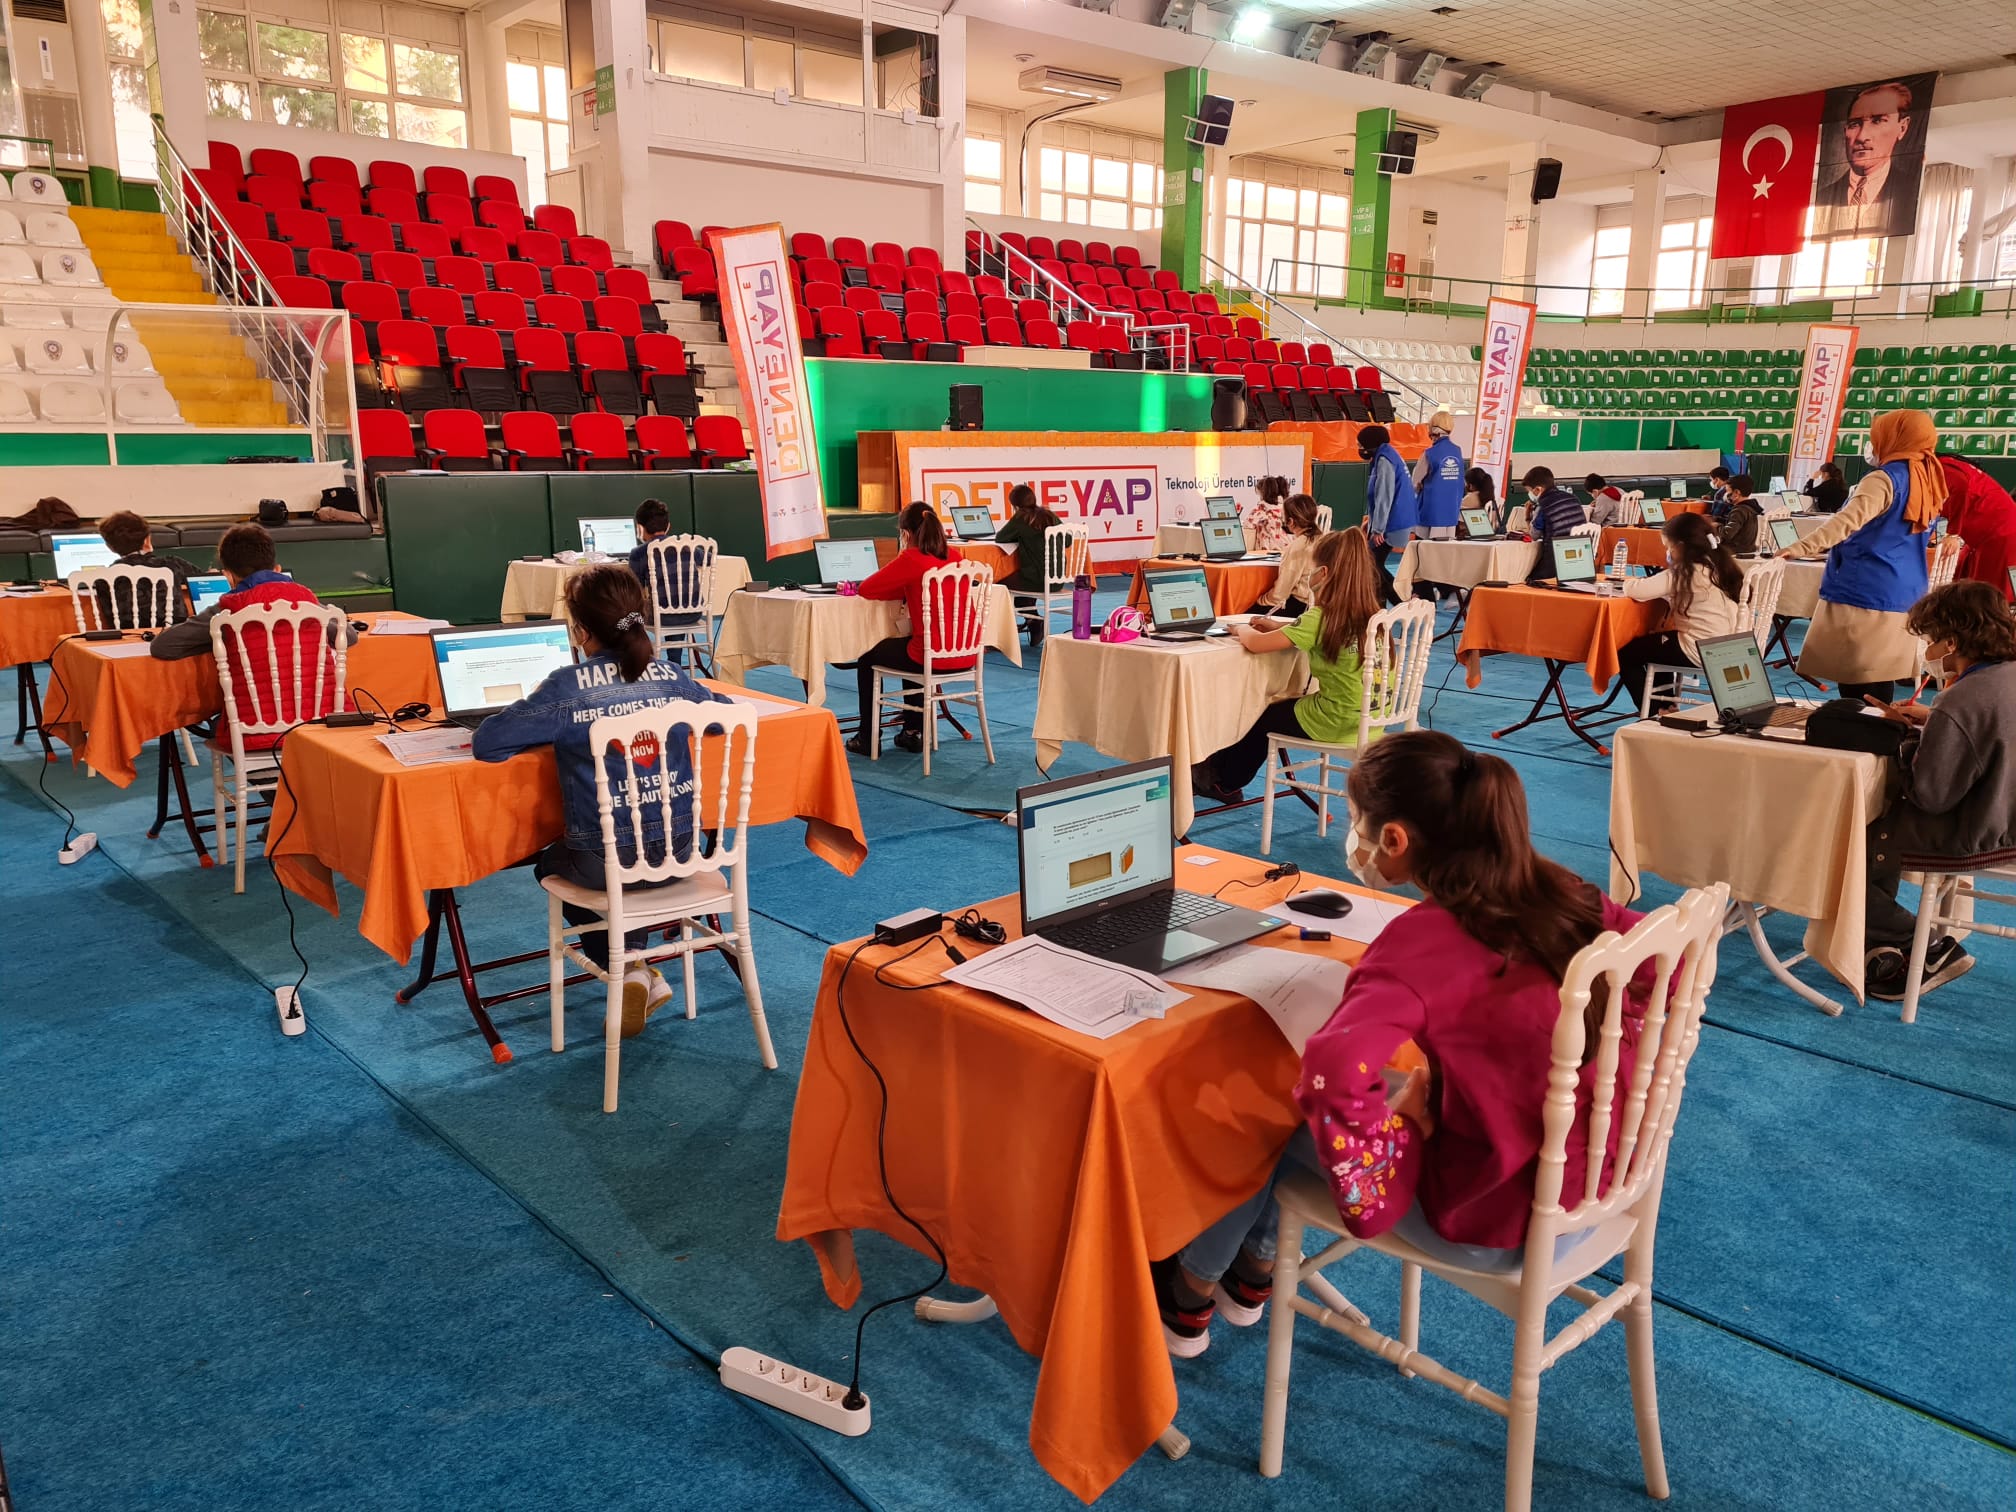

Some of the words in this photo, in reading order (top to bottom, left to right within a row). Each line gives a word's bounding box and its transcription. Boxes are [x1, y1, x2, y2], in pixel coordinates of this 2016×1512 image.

[1476, 326, 1511, 461] DENEYAP
[1800, 346, 1831, 456] DENEYAP
[1165, 476, 1210, 493] Teknoloji
[1212, 472, 1245, 489] Üreten
[1247, 475, 1259, 488] Bi
[576, 662, 678, 690] HAPNESS
[573, 707, 604, 723] HERE
[608, 700, 645, 717] COMES
[632, 744, 654, 758] NOW
[618, 776, 650, 792] LE'S
[651, 770, 679, 787] EOY
[677, 779, 693, 794] DAY
